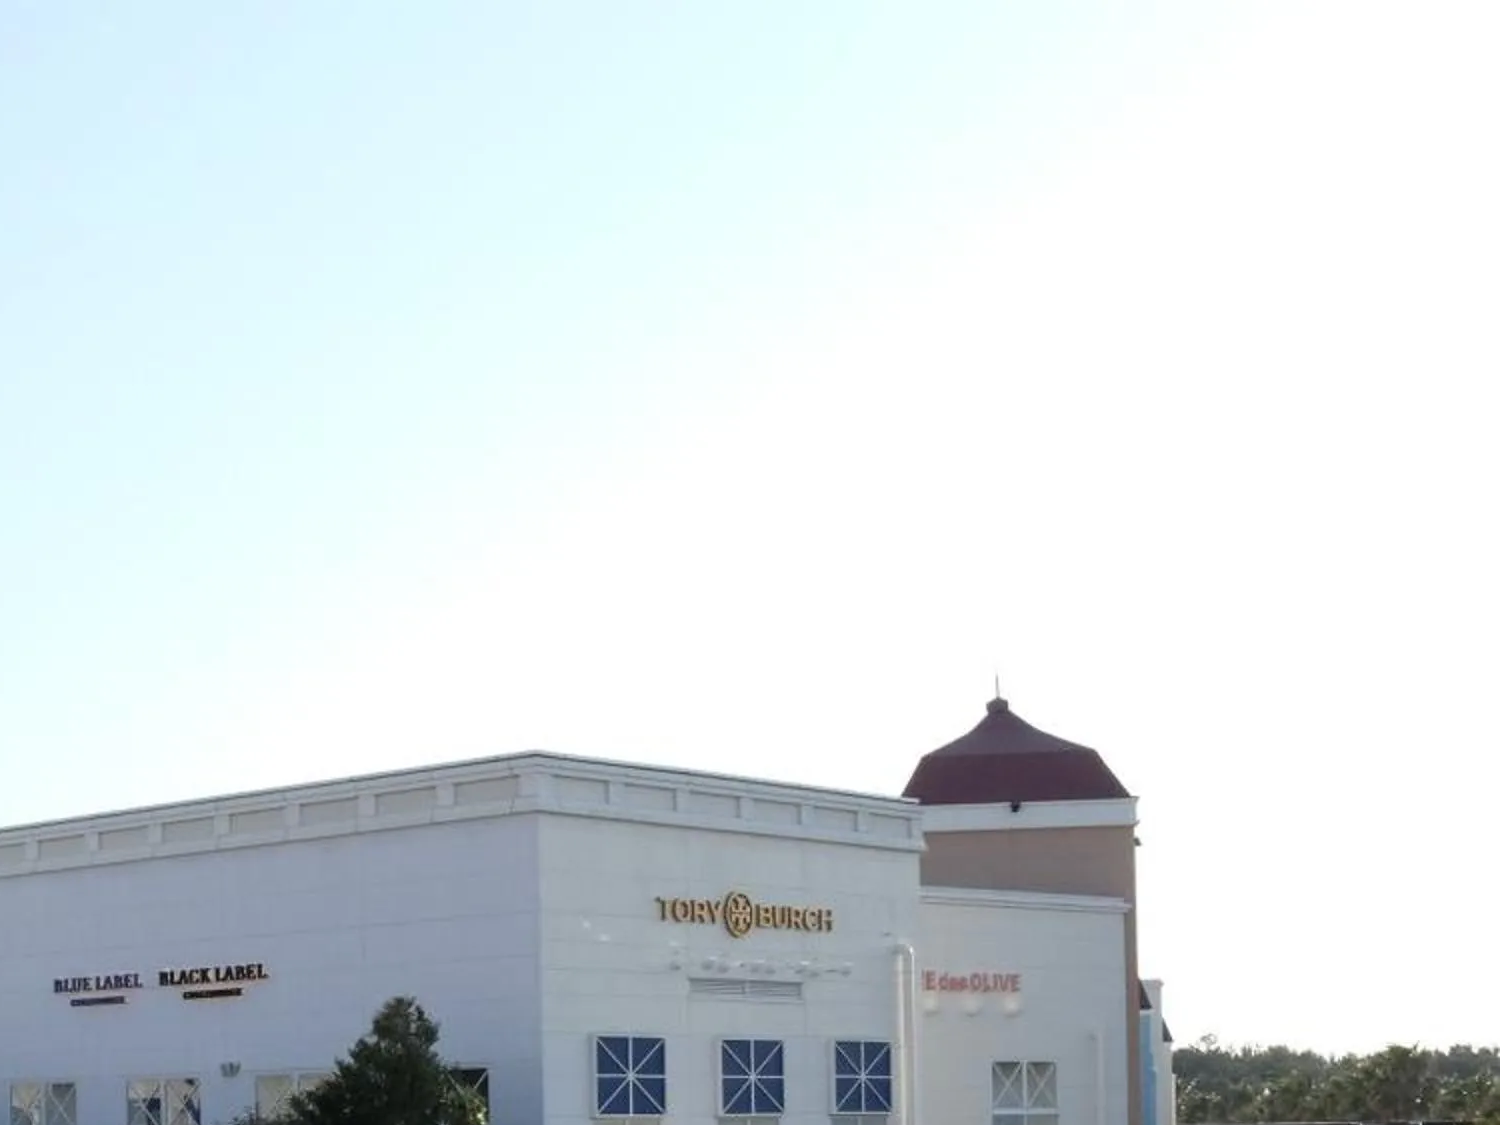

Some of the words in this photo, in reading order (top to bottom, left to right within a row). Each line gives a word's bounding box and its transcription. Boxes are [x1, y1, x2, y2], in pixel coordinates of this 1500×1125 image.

[655, 896, 721, 924] TORY
[754, 904, 834, 933] BURCH
[53, 977, 92, 993] BLUE
[95, 972, 143, 990] LABEL
[158, 967, 211, 986] BLACK
[214, 962, 269, 981] LABEL
